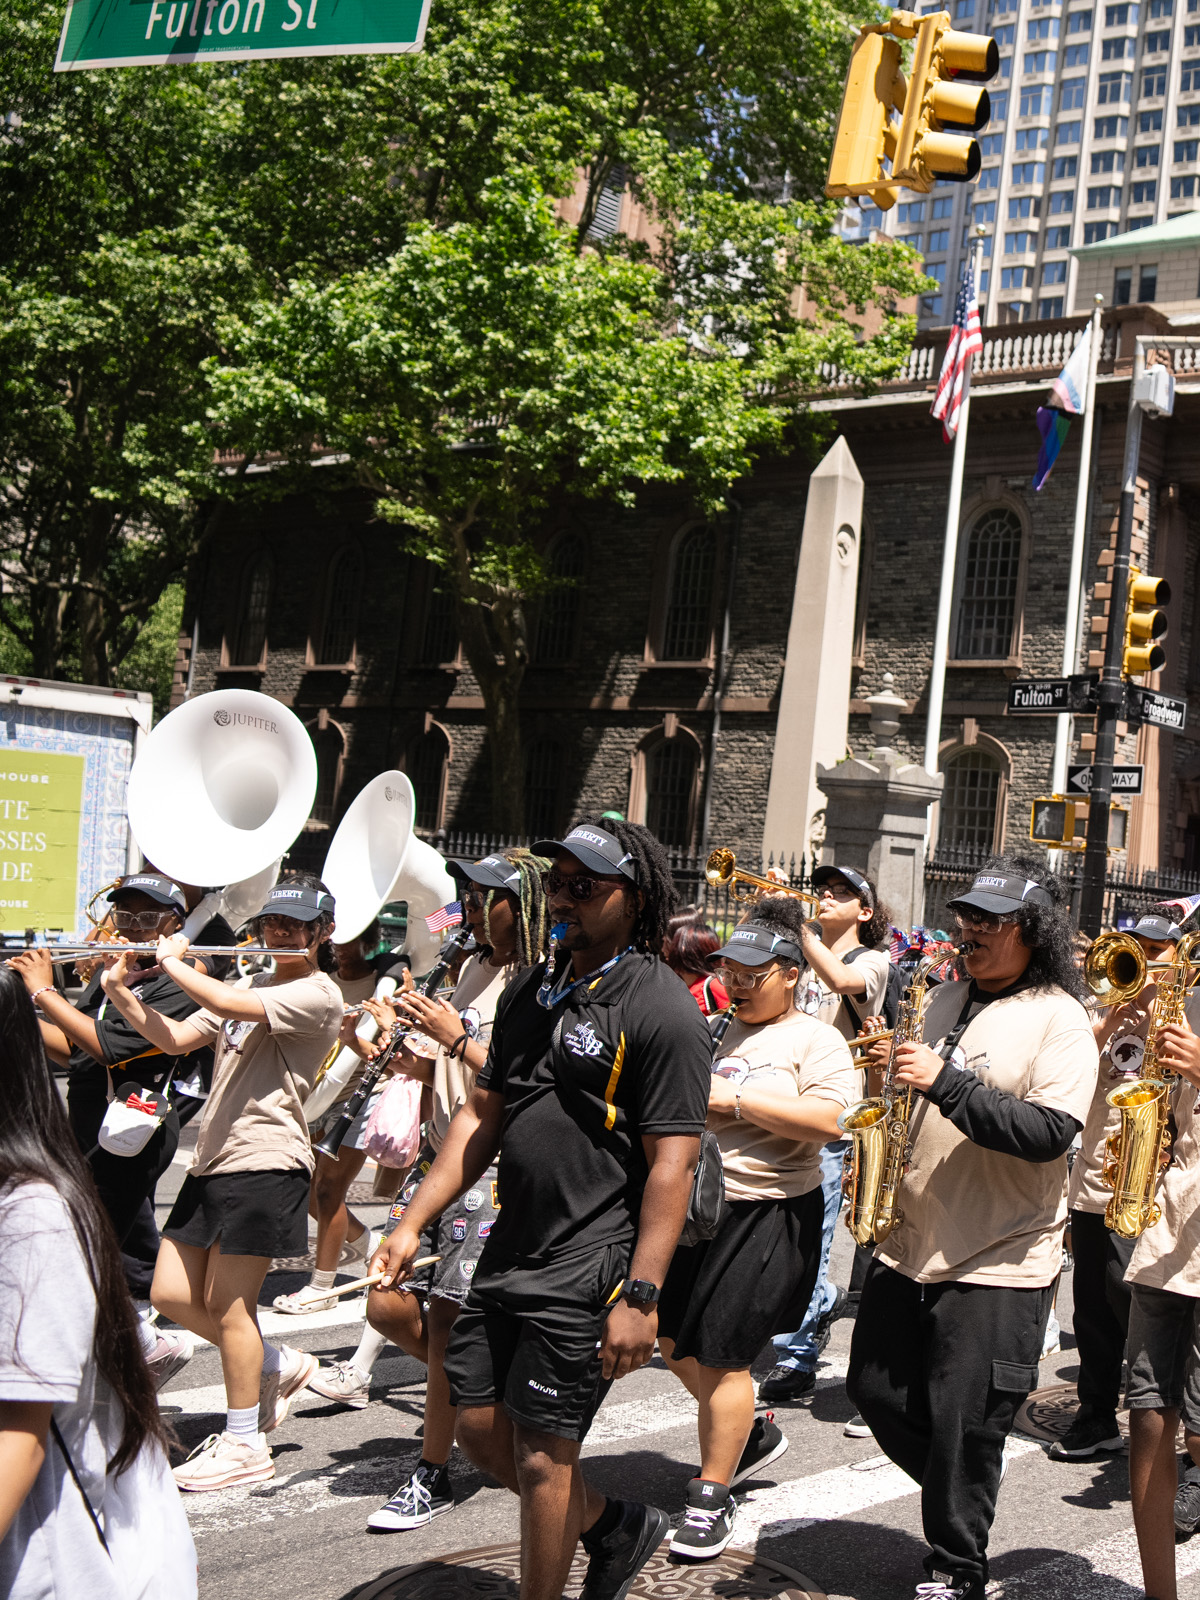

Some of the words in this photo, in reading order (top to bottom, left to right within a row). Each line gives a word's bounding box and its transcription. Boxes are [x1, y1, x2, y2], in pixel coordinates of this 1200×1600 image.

[145, 0, 265, 39] Fulton
[281, 0, 317, 31] St
[1013, 689, 1052, 706] Fulton
[1054, 688, 1063, 698] ST
[1143, 699, 1182, 726] Broadway
[233, 712, 279, 734] JUPITER
[1112, 773, 1134, 785] WAY
[271, 889, 304, 899] LIBERTY
[453, 1226, 464, 1237] 96
